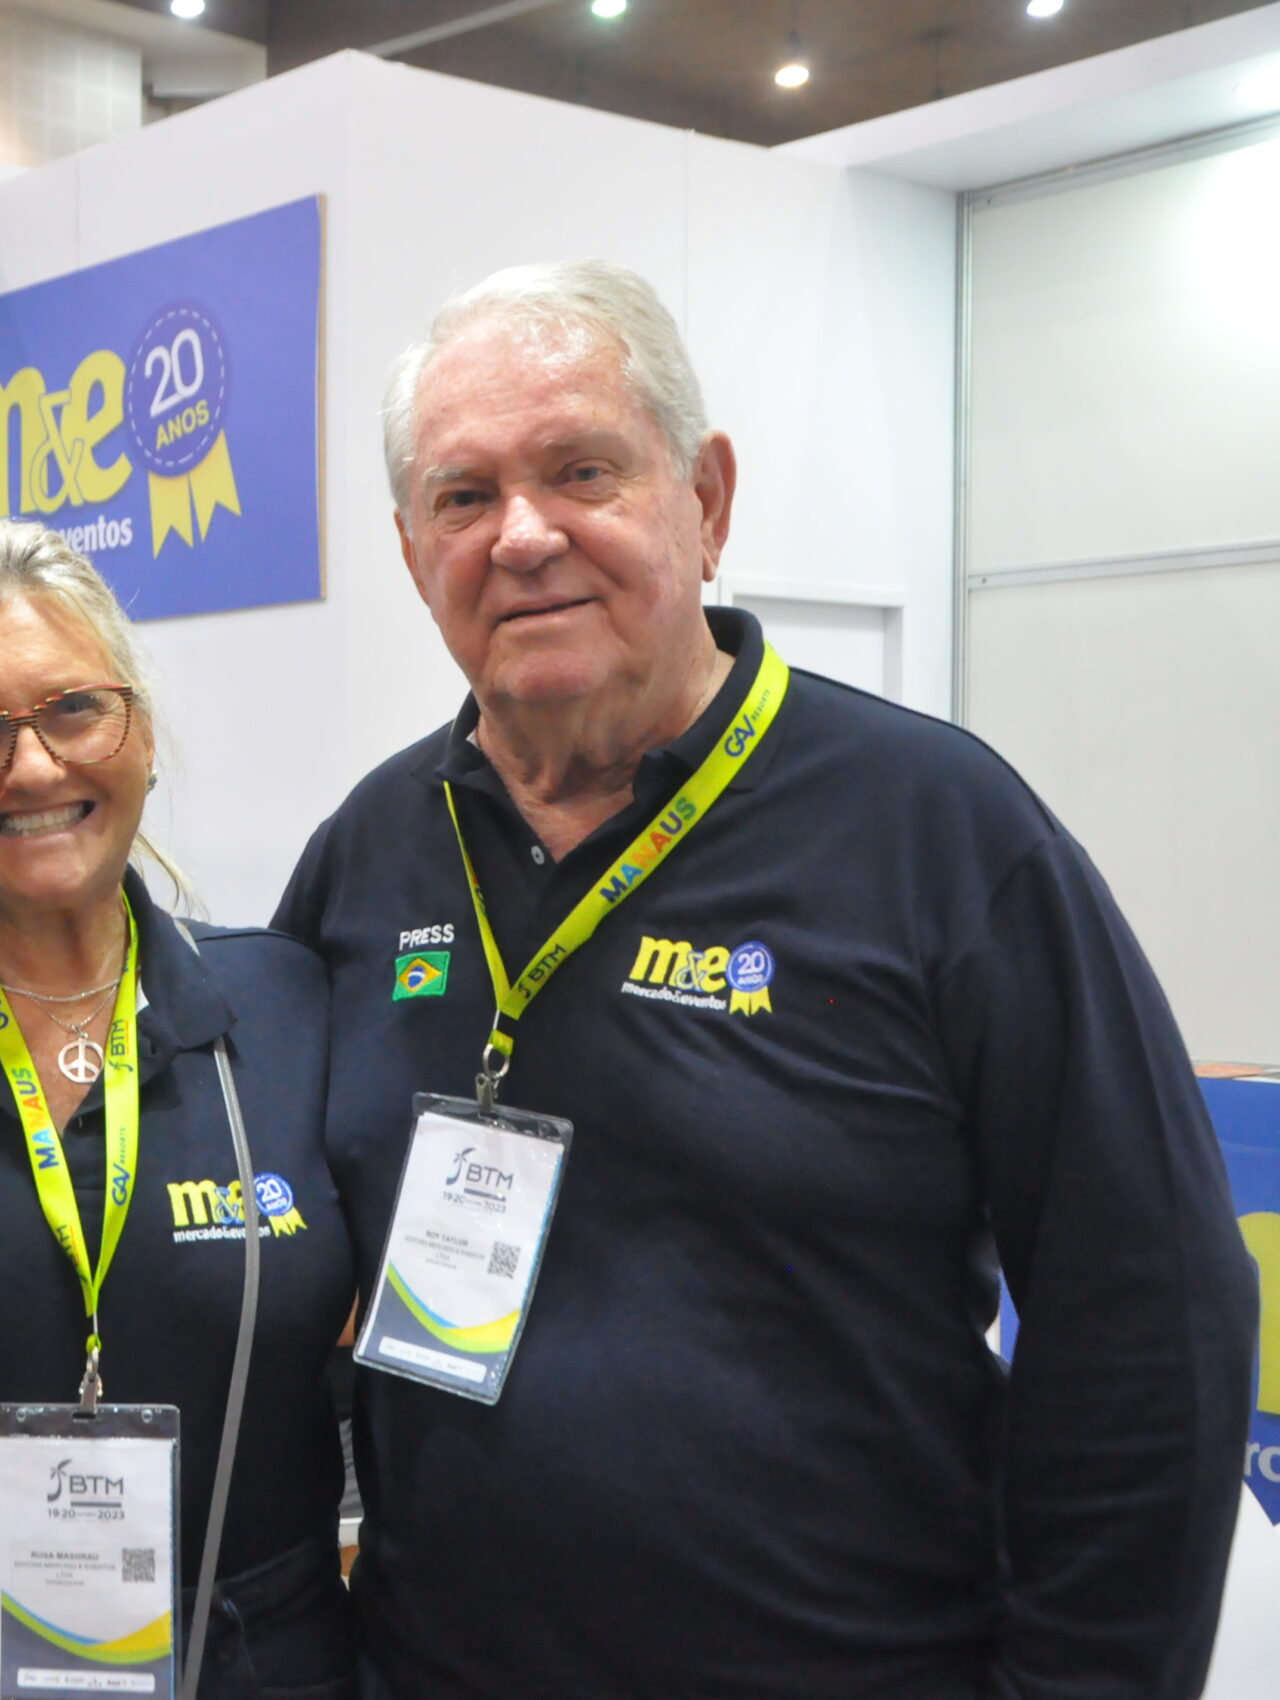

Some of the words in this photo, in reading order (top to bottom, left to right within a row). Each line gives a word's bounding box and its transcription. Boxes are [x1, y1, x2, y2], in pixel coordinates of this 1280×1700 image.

[144, 328, 204, 418] 20
[156, 399, 210, 450] ANOS
[600, 796, 697, 904] MANAUS
[399, 923, 454, 951] PRESS
[528, 943, 567, 983] BTM
[629, 935, 730, 993] m&e
[737, 951, 766, 976] 20
[11, 1066, 59, 1171] MANAUS
[256, 1179, 284, 1203] 20
[466, 1163, 515, 1190] BTM
[69, 1474, 124, 1495] BTM
